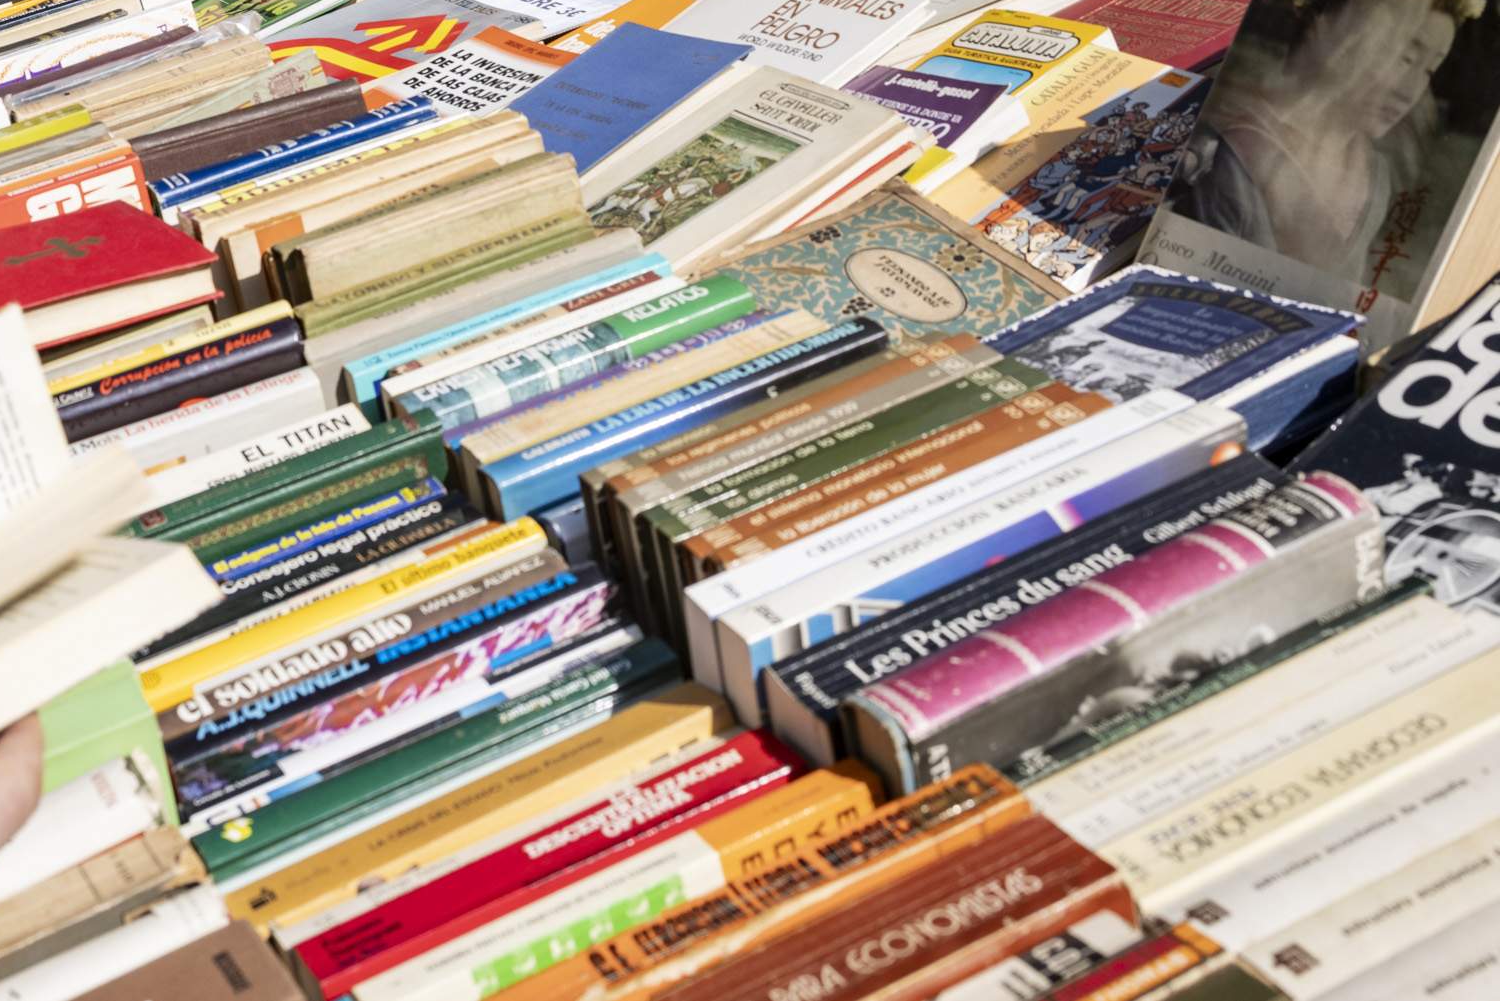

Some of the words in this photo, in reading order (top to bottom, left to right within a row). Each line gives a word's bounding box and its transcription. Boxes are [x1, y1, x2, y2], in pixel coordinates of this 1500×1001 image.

[773, 0, 811, 19] EN
[736, 33, 767, 48] WORLD
[766, 41, 801, 58] WILDLIFE
[798, 48, 824, 62] FUND
[750, 15, 841, 50] PELIGRO
[417, 66, 436, 80] DE
[435, 74, 462, 90] LAS
[462, 85, 507, 103] CAJAS
[430, 56, 449, 69] DE
[449, 63, 469, 77] LA
[469, 71, 512, 94] BANCA
[513, 84, 533, 95] Y
[451, 48, 470, 61] LA
[470, 54, 545, 84] INVERSION
[402, 77, 421, 90] DE
[420, 85, 488, 112] AHORROS
[758, 89, 776, 102] EL
[1150, 227, 1196, 259] Fosco
[1201, 250, 1281, 294] Maraini
[622, 285, 710, 323] RELATOS
[184, 351, 202, 366] en
[201, 344, 220, 361] la
[593, 415, 622, 436] LA
[620, 401, 660, 427] ERA
[661, 389, 691, 413] DE
[689, 377, 717, 400] LA
[714, 319, 866, 388] INCERTIDUMBRE
[122, 423, 148, 439] La
[147, 402, 202, 432] herida
[203, 396, 225, 413] de
[226, 391, 242, 407] la
[241, 443, 276, 463] EL
[277, 413, 353, 449] TITAN
[220, 550, 320, 596] Consejero
[317, 529, 368, 560] legal
[844, 642, 911, 685] Les
[907, 590, 1023, 664] Princes
[1018, 571, 1061, 608] du
[1059, 540, 1136, 597] sang
[1141, 502, 1206, 546] Gilbert
[176, 693, 213, 724] el
[212, 638, 347, 706] soldado
